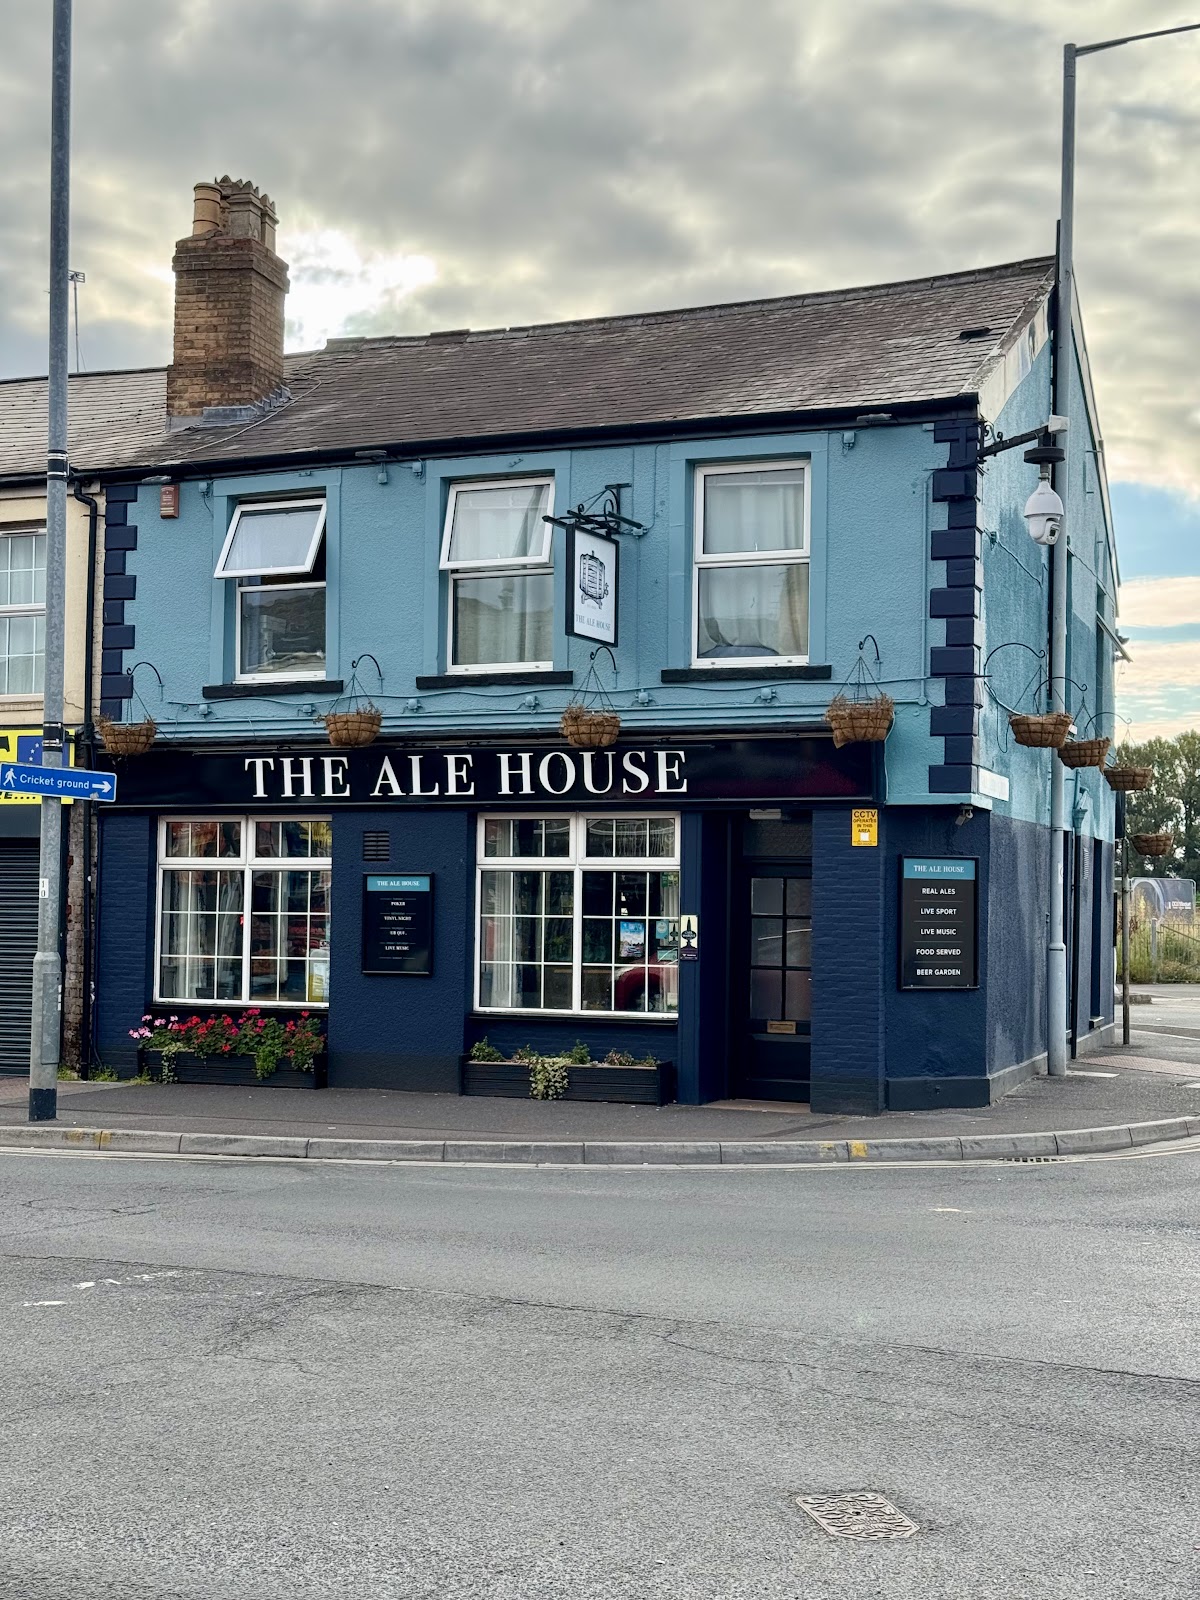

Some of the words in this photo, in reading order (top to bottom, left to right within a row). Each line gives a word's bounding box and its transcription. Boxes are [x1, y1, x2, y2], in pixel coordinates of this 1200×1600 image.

[576, 614, 585, 624] THE
[586, 617, 595, 627] ALE
[596, 620, 611, 632] HOUSE
[244, 756, 351, 798] THE
[369, 754, 476, 797] ALE
[495, 750, 688, 795] HOUSE
[20, 774, 54, 786] Cricket
[57, 780, 90, 790] ground
[853, 810, 877, 818] CCTV
[928, 865, 942, 873] ALE
[943, 865, 965, 873] HOUSE
[936, 948, 961, 956] SERVED
